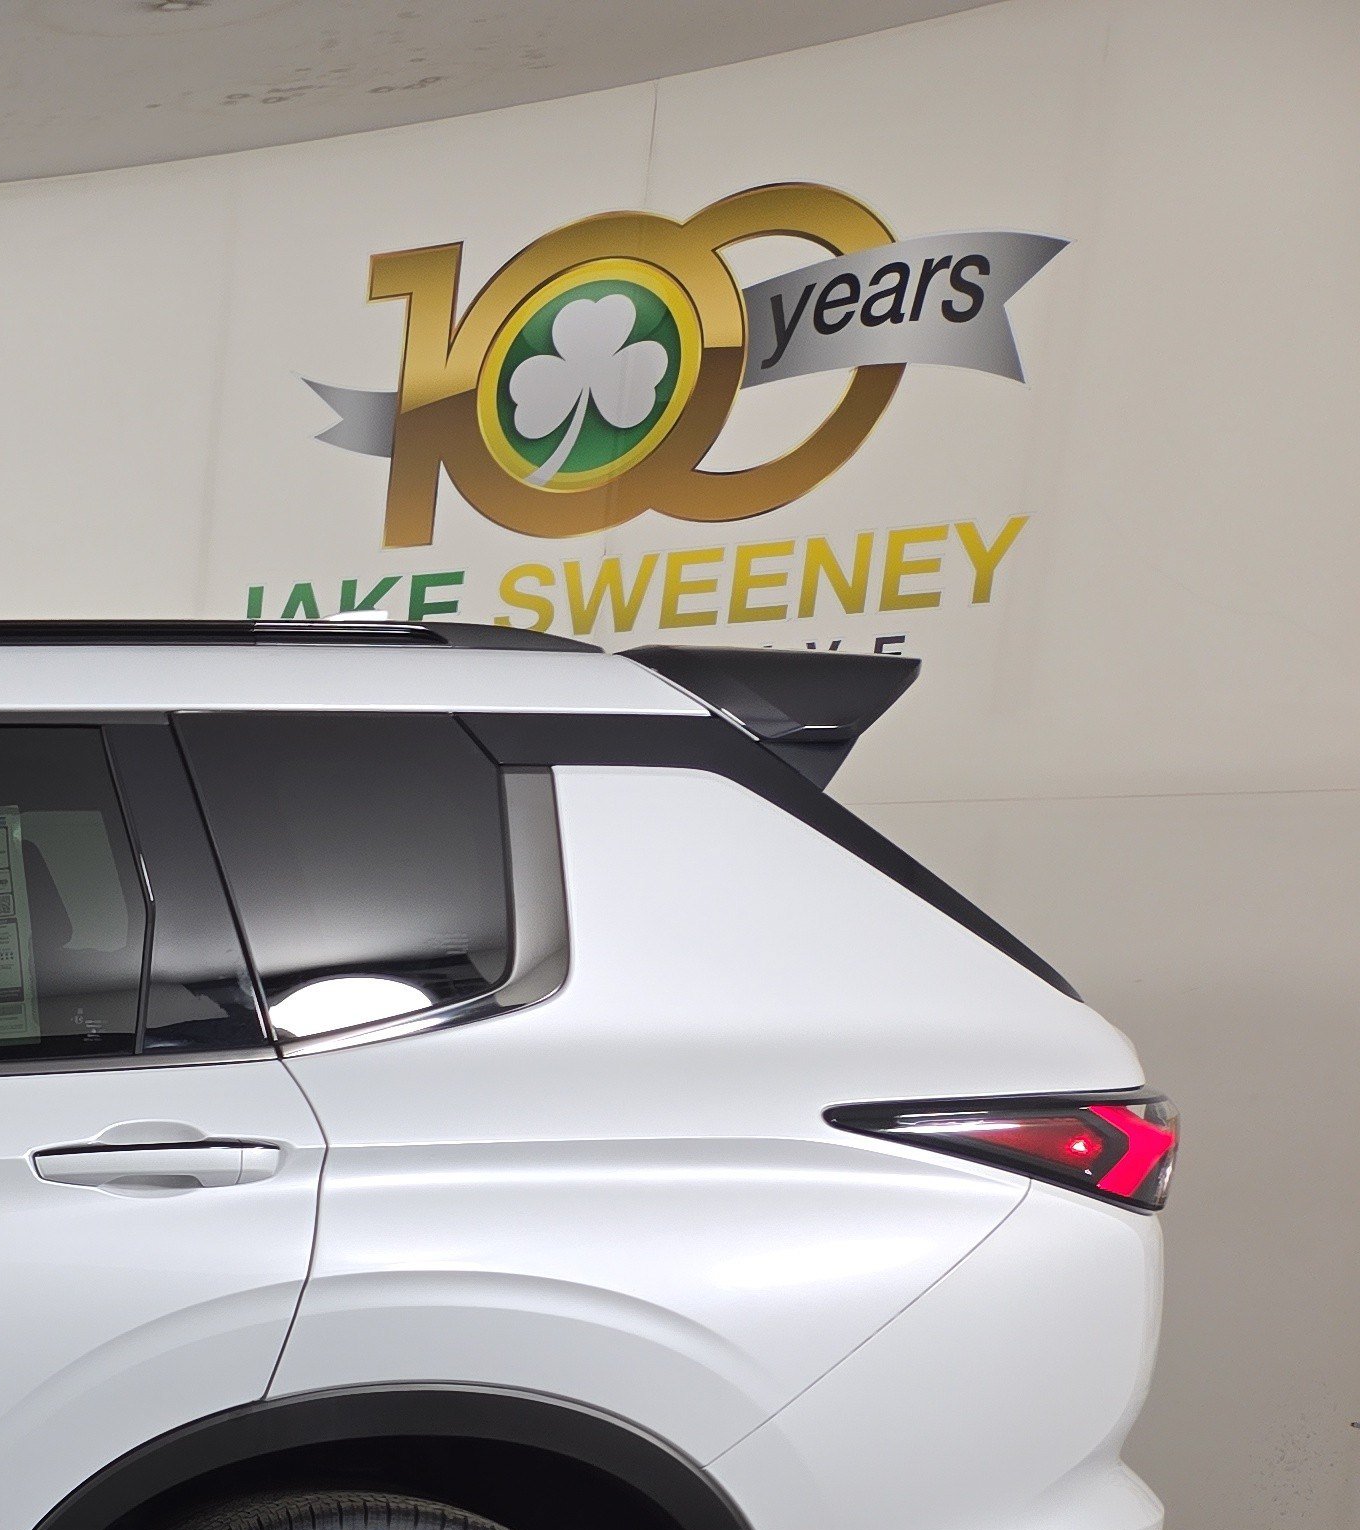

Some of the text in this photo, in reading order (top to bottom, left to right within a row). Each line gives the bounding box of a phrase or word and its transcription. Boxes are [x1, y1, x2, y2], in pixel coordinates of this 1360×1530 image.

[368, 182, 992, 550] 100 years
[493, 515, 1030, 636] SWEENEY
